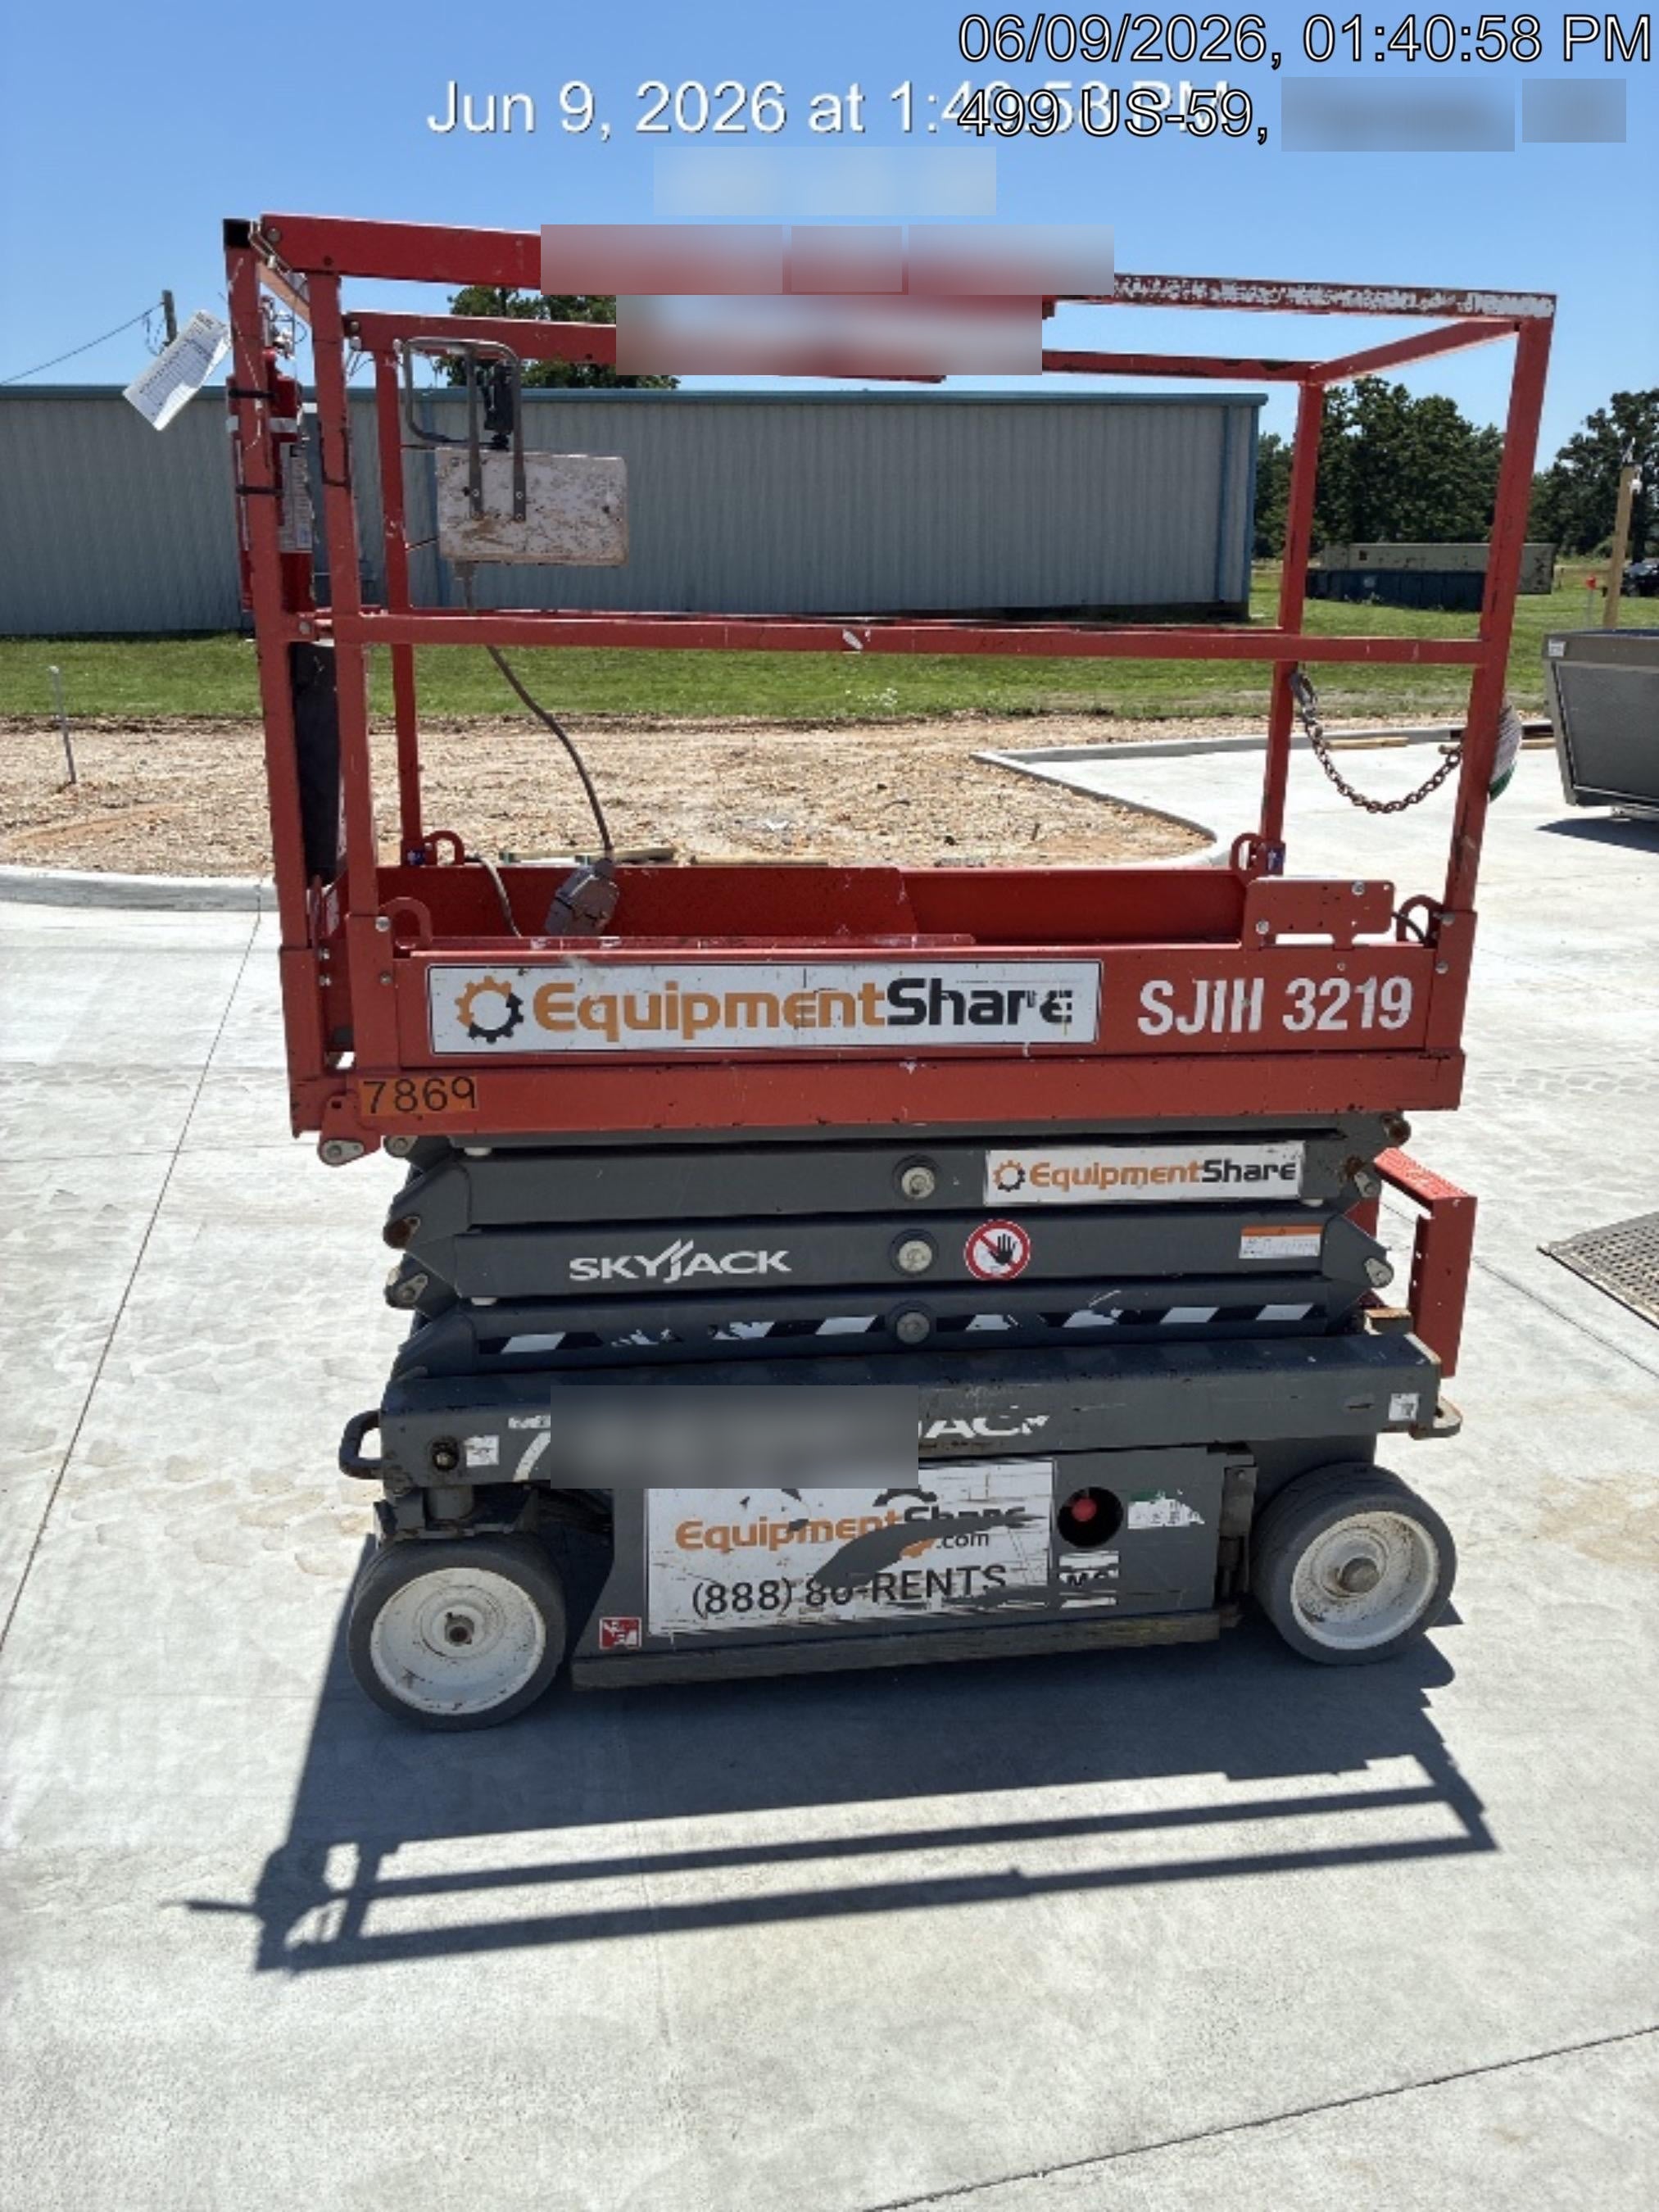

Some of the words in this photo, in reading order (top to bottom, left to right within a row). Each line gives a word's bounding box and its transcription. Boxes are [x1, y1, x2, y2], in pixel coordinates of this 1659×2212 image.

[532, 977, 1072, 1043] EquipmentShare
[1282, 976, 1414, 1031] 3219
[363, 1076, 476, 1114] 7869
[1029, 1150, 1297, 1192] EquipmentShare
[569, 1238, 792, 1284] SKYJACK
[692, 1578, 793, 1619] (888)
